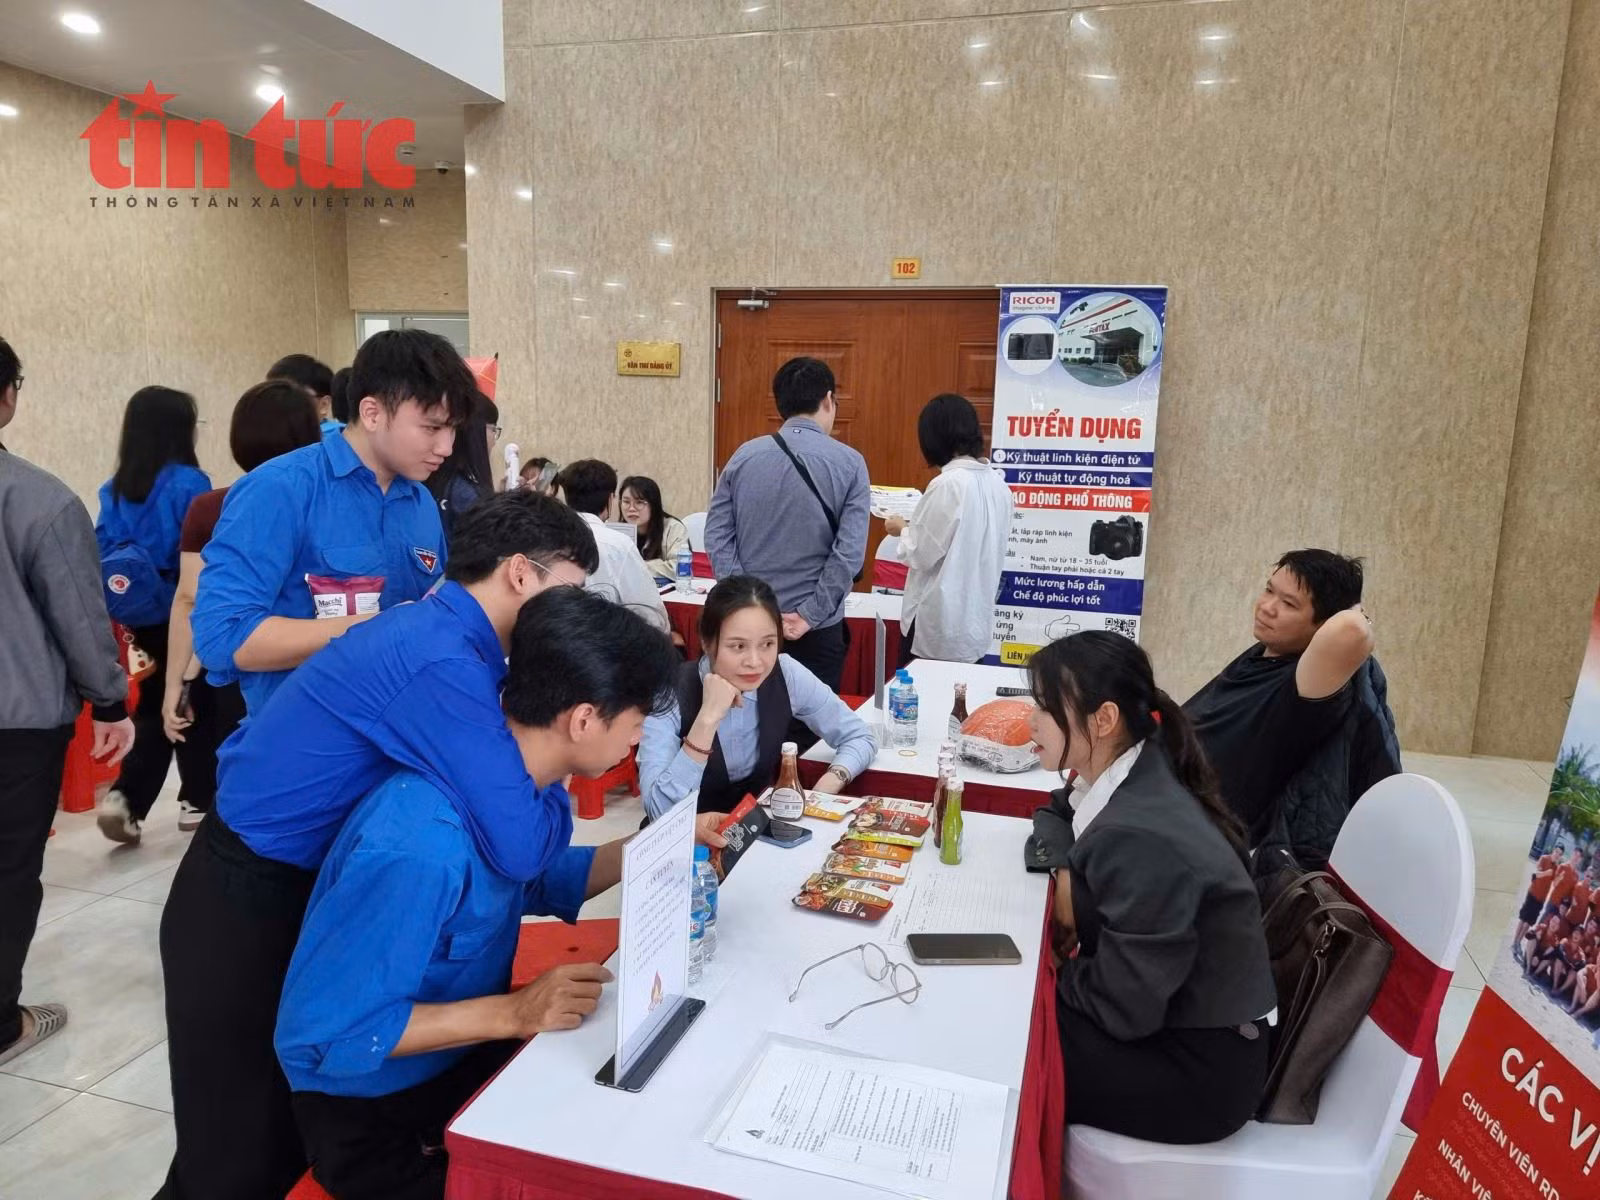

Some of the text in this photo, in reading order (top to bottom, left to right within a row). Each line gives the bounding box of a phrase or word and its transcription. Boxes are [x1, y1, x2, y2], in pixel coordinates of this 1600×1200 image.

[896, 262, 916, 275] 102
[1012, 296, 1056, 305] RICOH
[1007, 408, 1141, 443] TUYỂN DỤNG
[1006, 451, 1021, 464] Kỹ
[1023, 451, 1049, 465] thuật
[1052, 453, 1072, 463] linh
[1075, 453, 1098, 466] kiện
[1101, 454, 1125, 467] điện
[1128, 454, 1141, 465] tử
[1018, 471, 1131, 486] Kỹ thuật tự động hoá
[1012, 489, 1133, 509] AO ĐỘNG PHỔ THÔNG
[1045, 529, 1057, 537] linh
[1059, 530, 1073, 539] kiện
[1014, 575, 1105, 591] Mức lương hấp dẫn
[1013, 589, 1101, 605] Chế độ phúc lợi tốt
[994, 608, 1011, 620] ăng
[1007, 649, 1023, 661] LIÊN
[689, 923, 698, 932] ie
[1501, 1047, 1600, 1177] CÁC VỊ
[1462, 1092, 1508, 1149] CHUYÊN
[1509, 1141, 1539, 1185] VIÊN
[1438, 1138, 1492, 1200] NHÂN VIÊ
